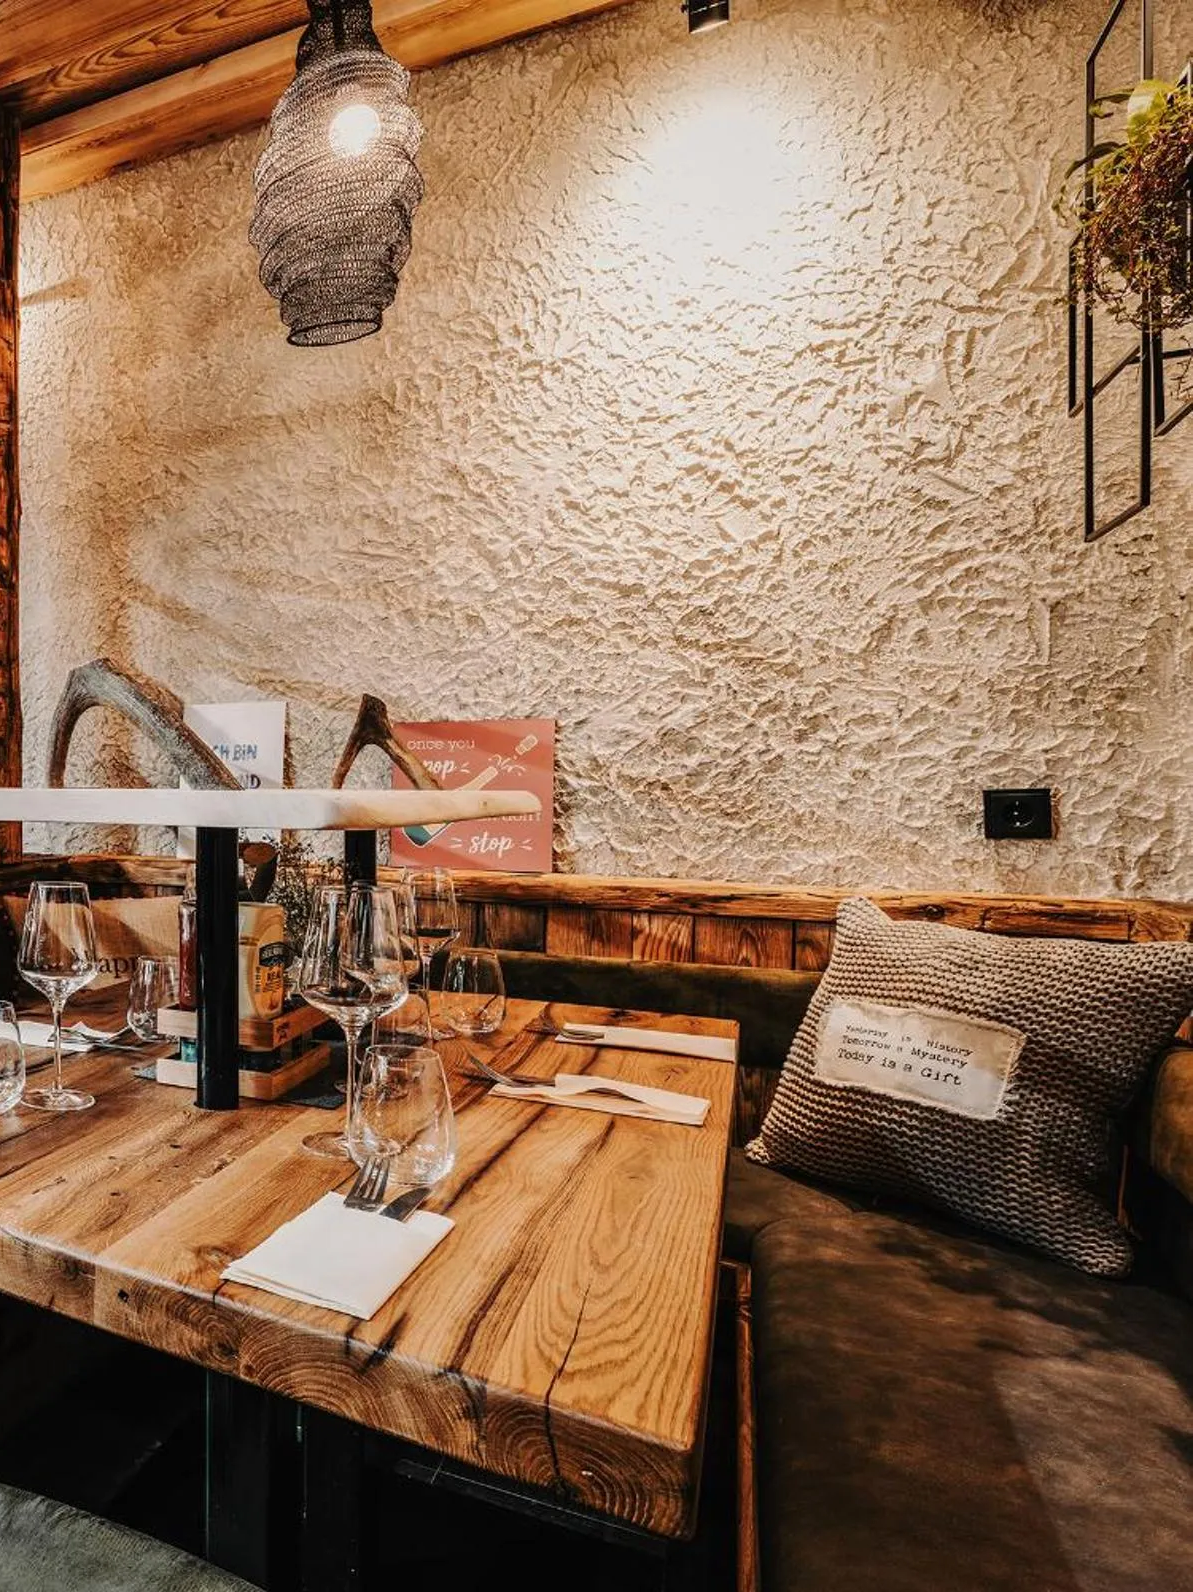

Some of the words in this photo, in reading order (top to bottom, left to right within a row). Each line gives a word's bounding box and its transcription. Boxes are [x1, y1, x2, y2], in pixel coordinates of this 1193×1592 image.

[407, 740, 444, 750] once
[448, 740, 475, 751] you
[468, 831, 515, 858] stop
[842, 1034, 892, 1050] Tomorrow
[911, 1047, 968, 1069] Mystery
[926, 1039, 974, 1058] History
[837, 1047, 875, 1065] Today
[881, 1056, 897, 1069] is
[903, 1063, 913, 1073] a
[920, 1066, 962, 1086] Gift
